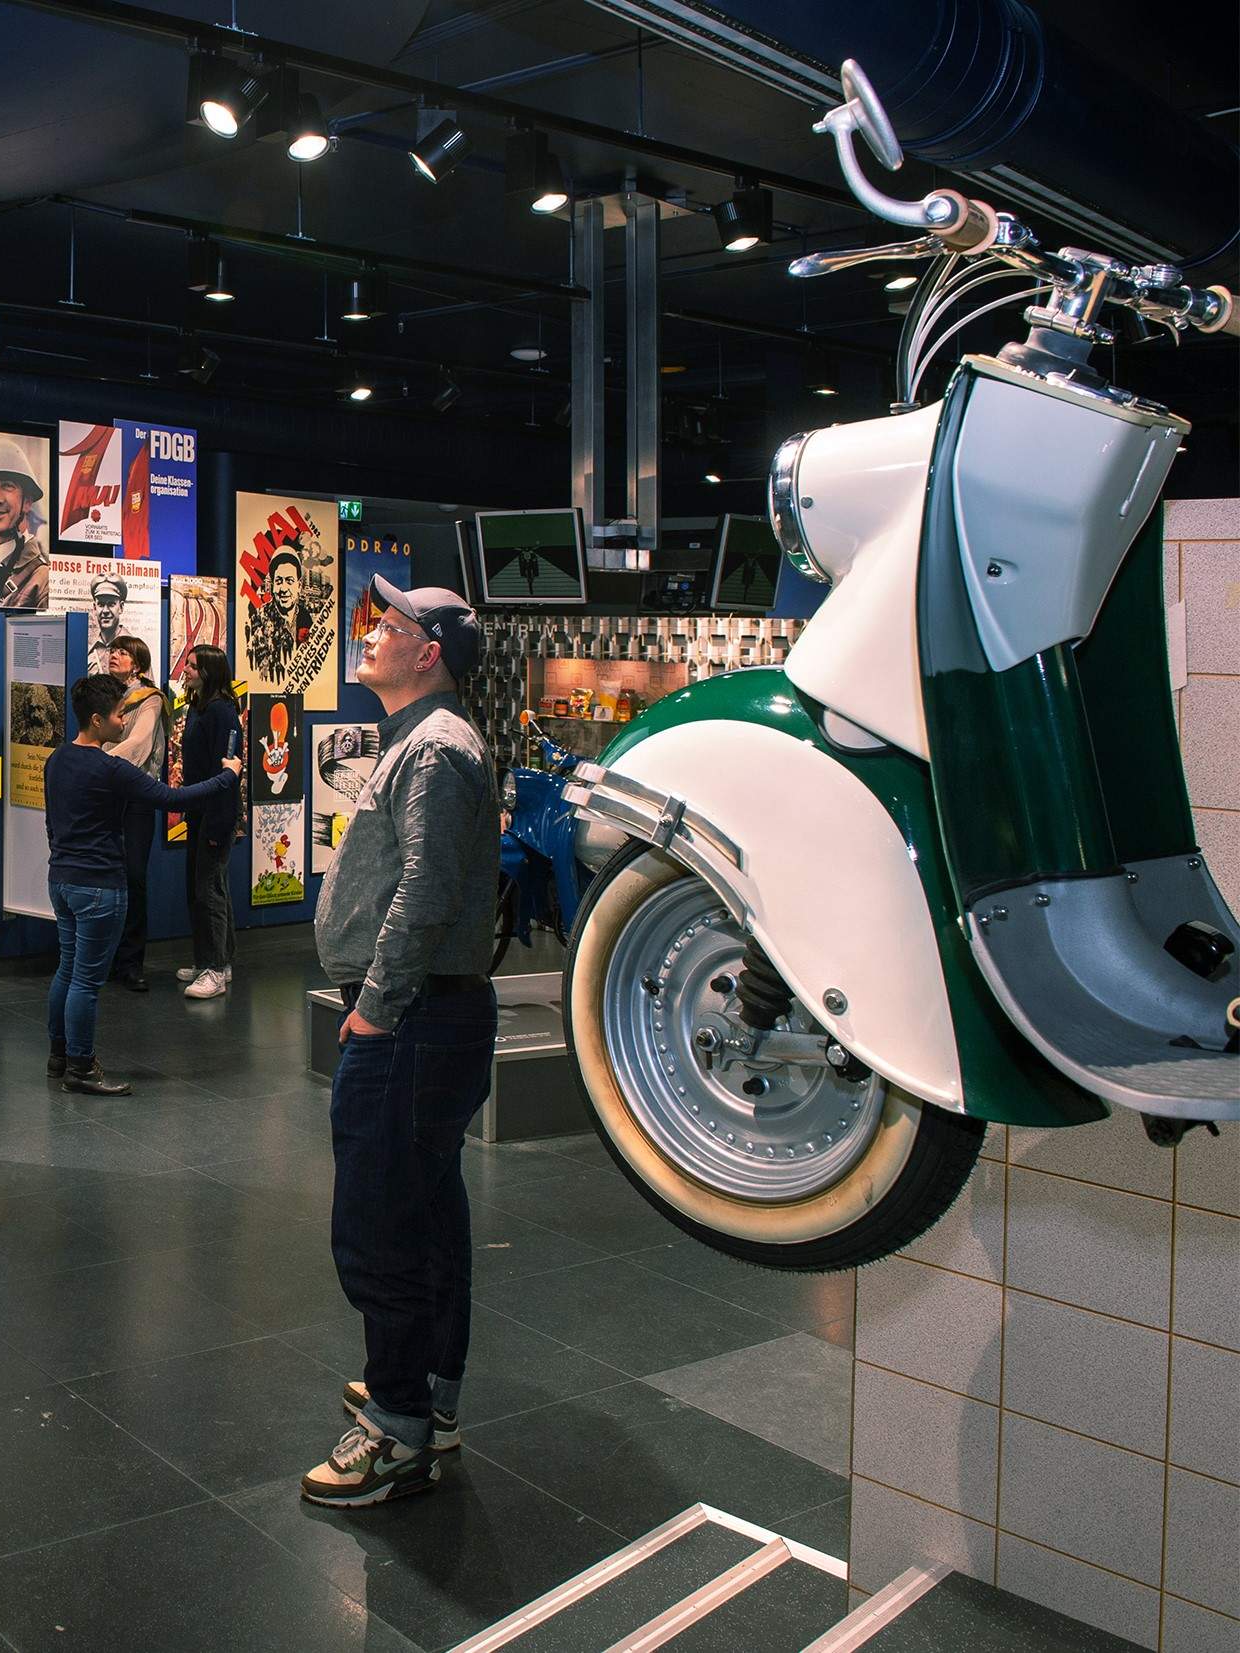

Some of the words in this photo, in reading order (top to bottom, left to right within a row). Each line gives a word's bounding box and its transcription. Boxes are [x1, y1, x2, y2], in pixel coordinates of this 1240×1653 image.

[135, 428, 147, 440] Der
[150, 430, 196, 463] FDGB
[150, 473, 168, 485] Deine
[167, 475, 194, 488] Klassen-
[150, 485, 189, 498] organisation
[239, 505, 314, 588] MAI
[347, 537, 382, 554] DDR
[391, 542, 411, 557] 40
[86, 560, 112, 575] Ernst
[116, 562, 160, 578] Thälmann
[286, 652, 301, 678] ALLES
[309, 623, 319, 640] DAS
[316, 598, 336, 626] WOHL
[292, 643, 317, 684] VOLKES
[313, 626, 327, 646] UND
[306, 628, 336, 682] FRIEDEN
